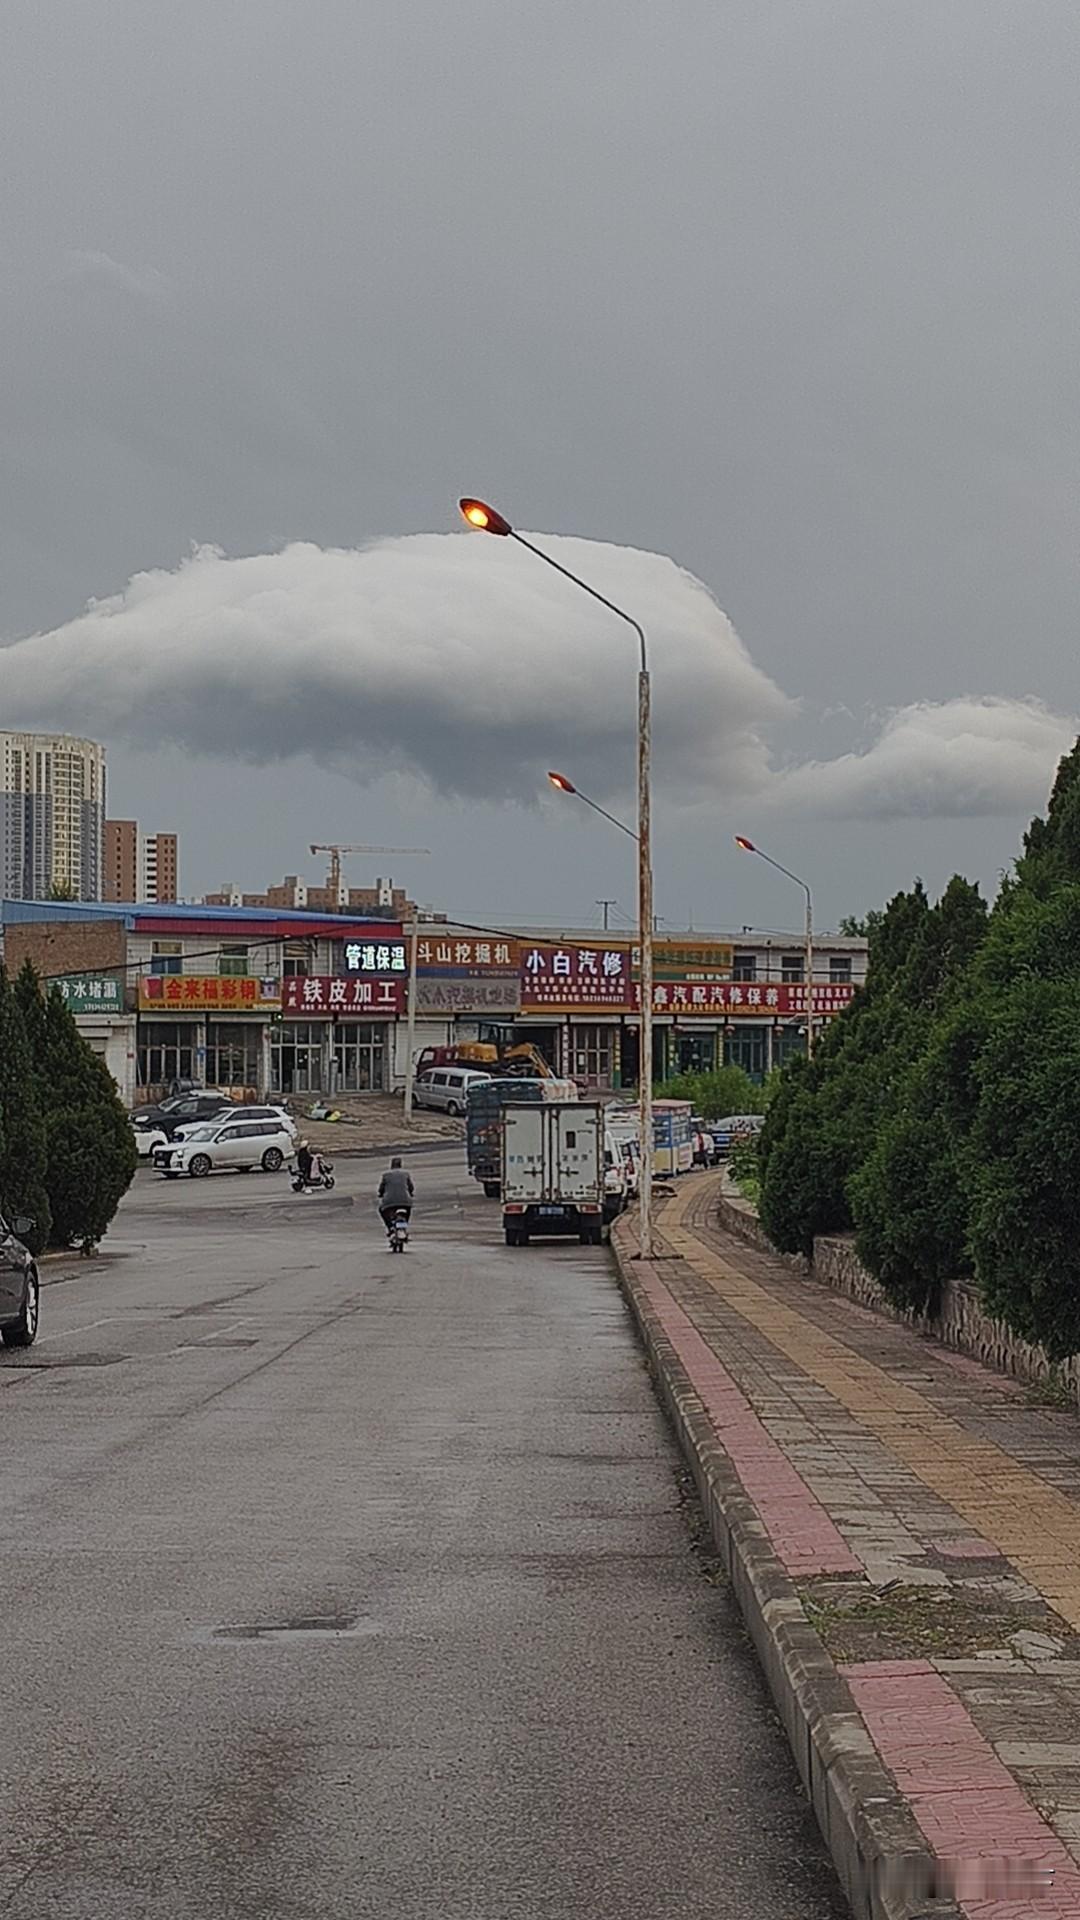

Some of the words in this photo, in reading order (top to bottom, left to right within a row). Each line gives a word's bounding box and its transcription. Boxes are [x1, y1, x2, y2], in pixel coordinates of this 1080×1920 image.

[345, 944, 406, 970] 管道保温
[417, 942, 511, 964] 斗山挖掘机
[526, 949, 622, 976] 小白汽修
[303, 979, 397, 1003] 铁皮加工
